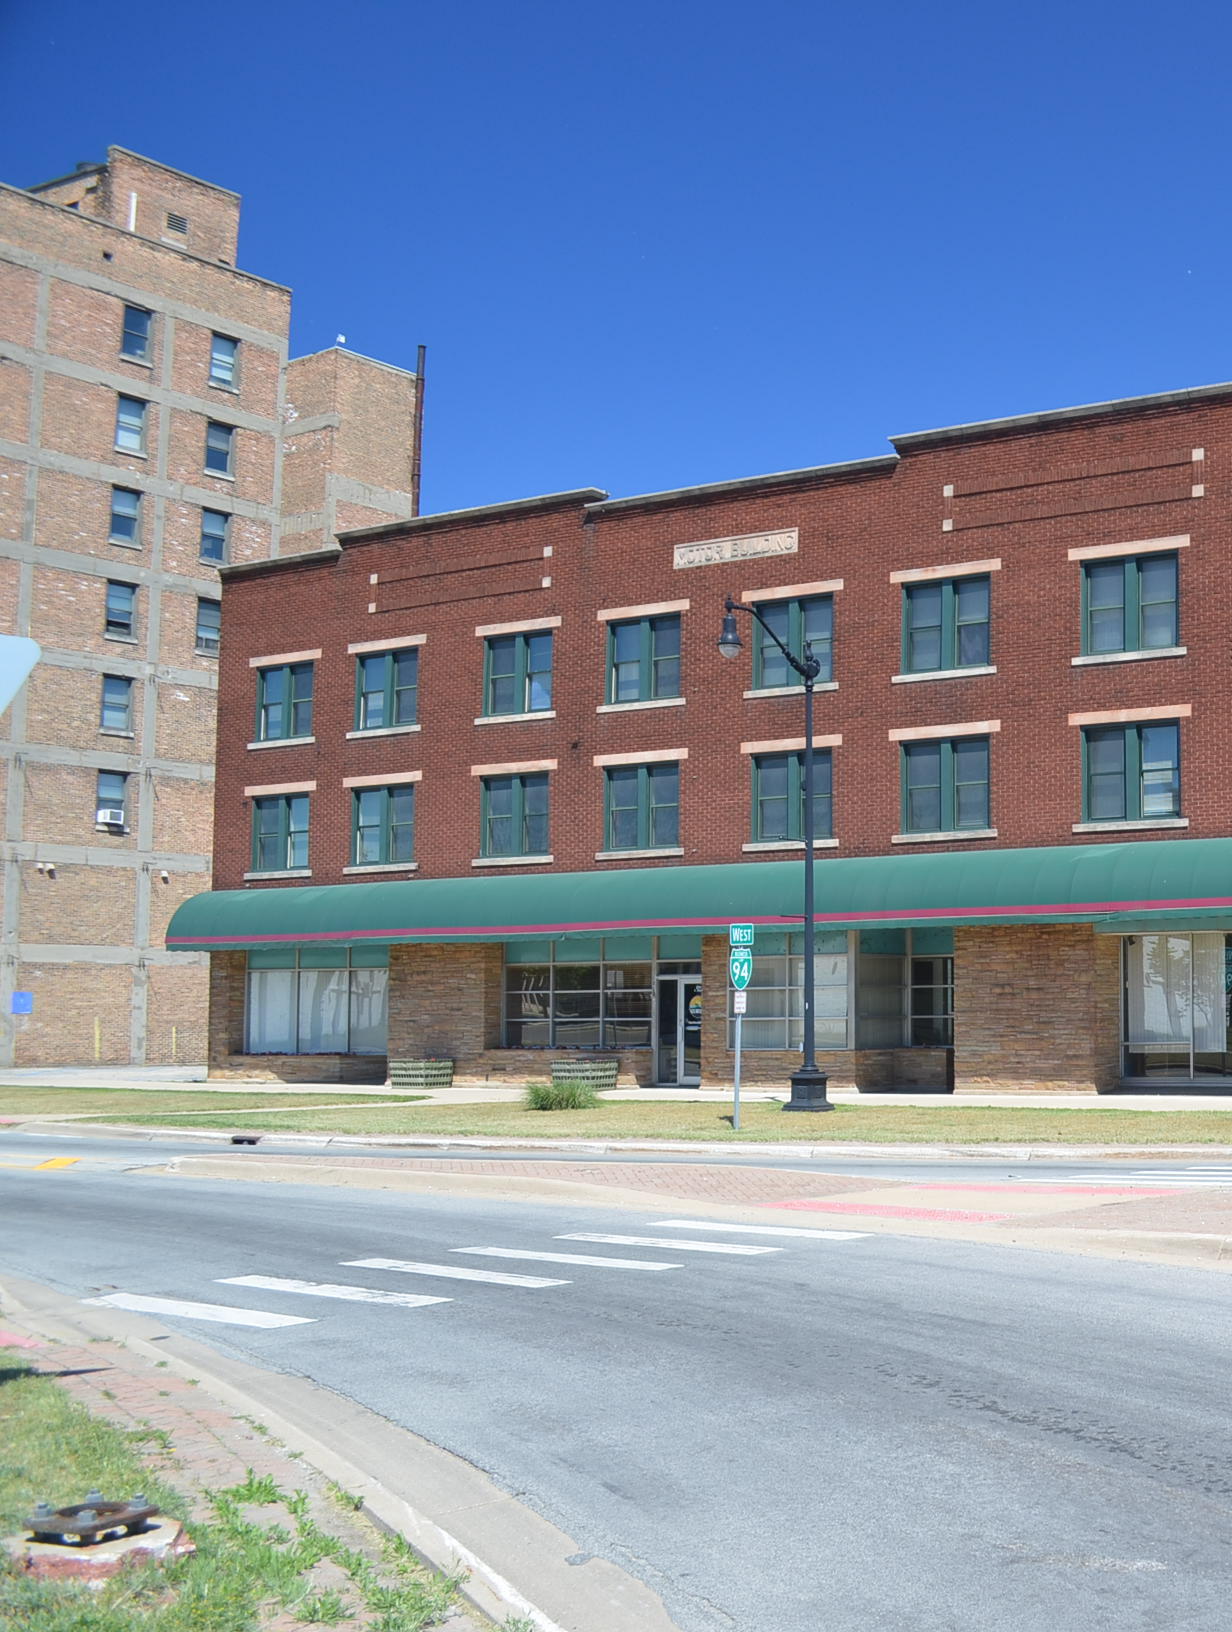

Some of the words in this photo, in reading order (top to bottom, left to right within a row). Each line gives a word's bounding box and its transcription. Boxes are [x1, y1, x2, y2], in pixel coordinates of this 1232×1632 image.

[730, 535, 795, 558] BUILDING
[732, 928, 752, 942] WEST
[732, 961, 749, 981] 94
